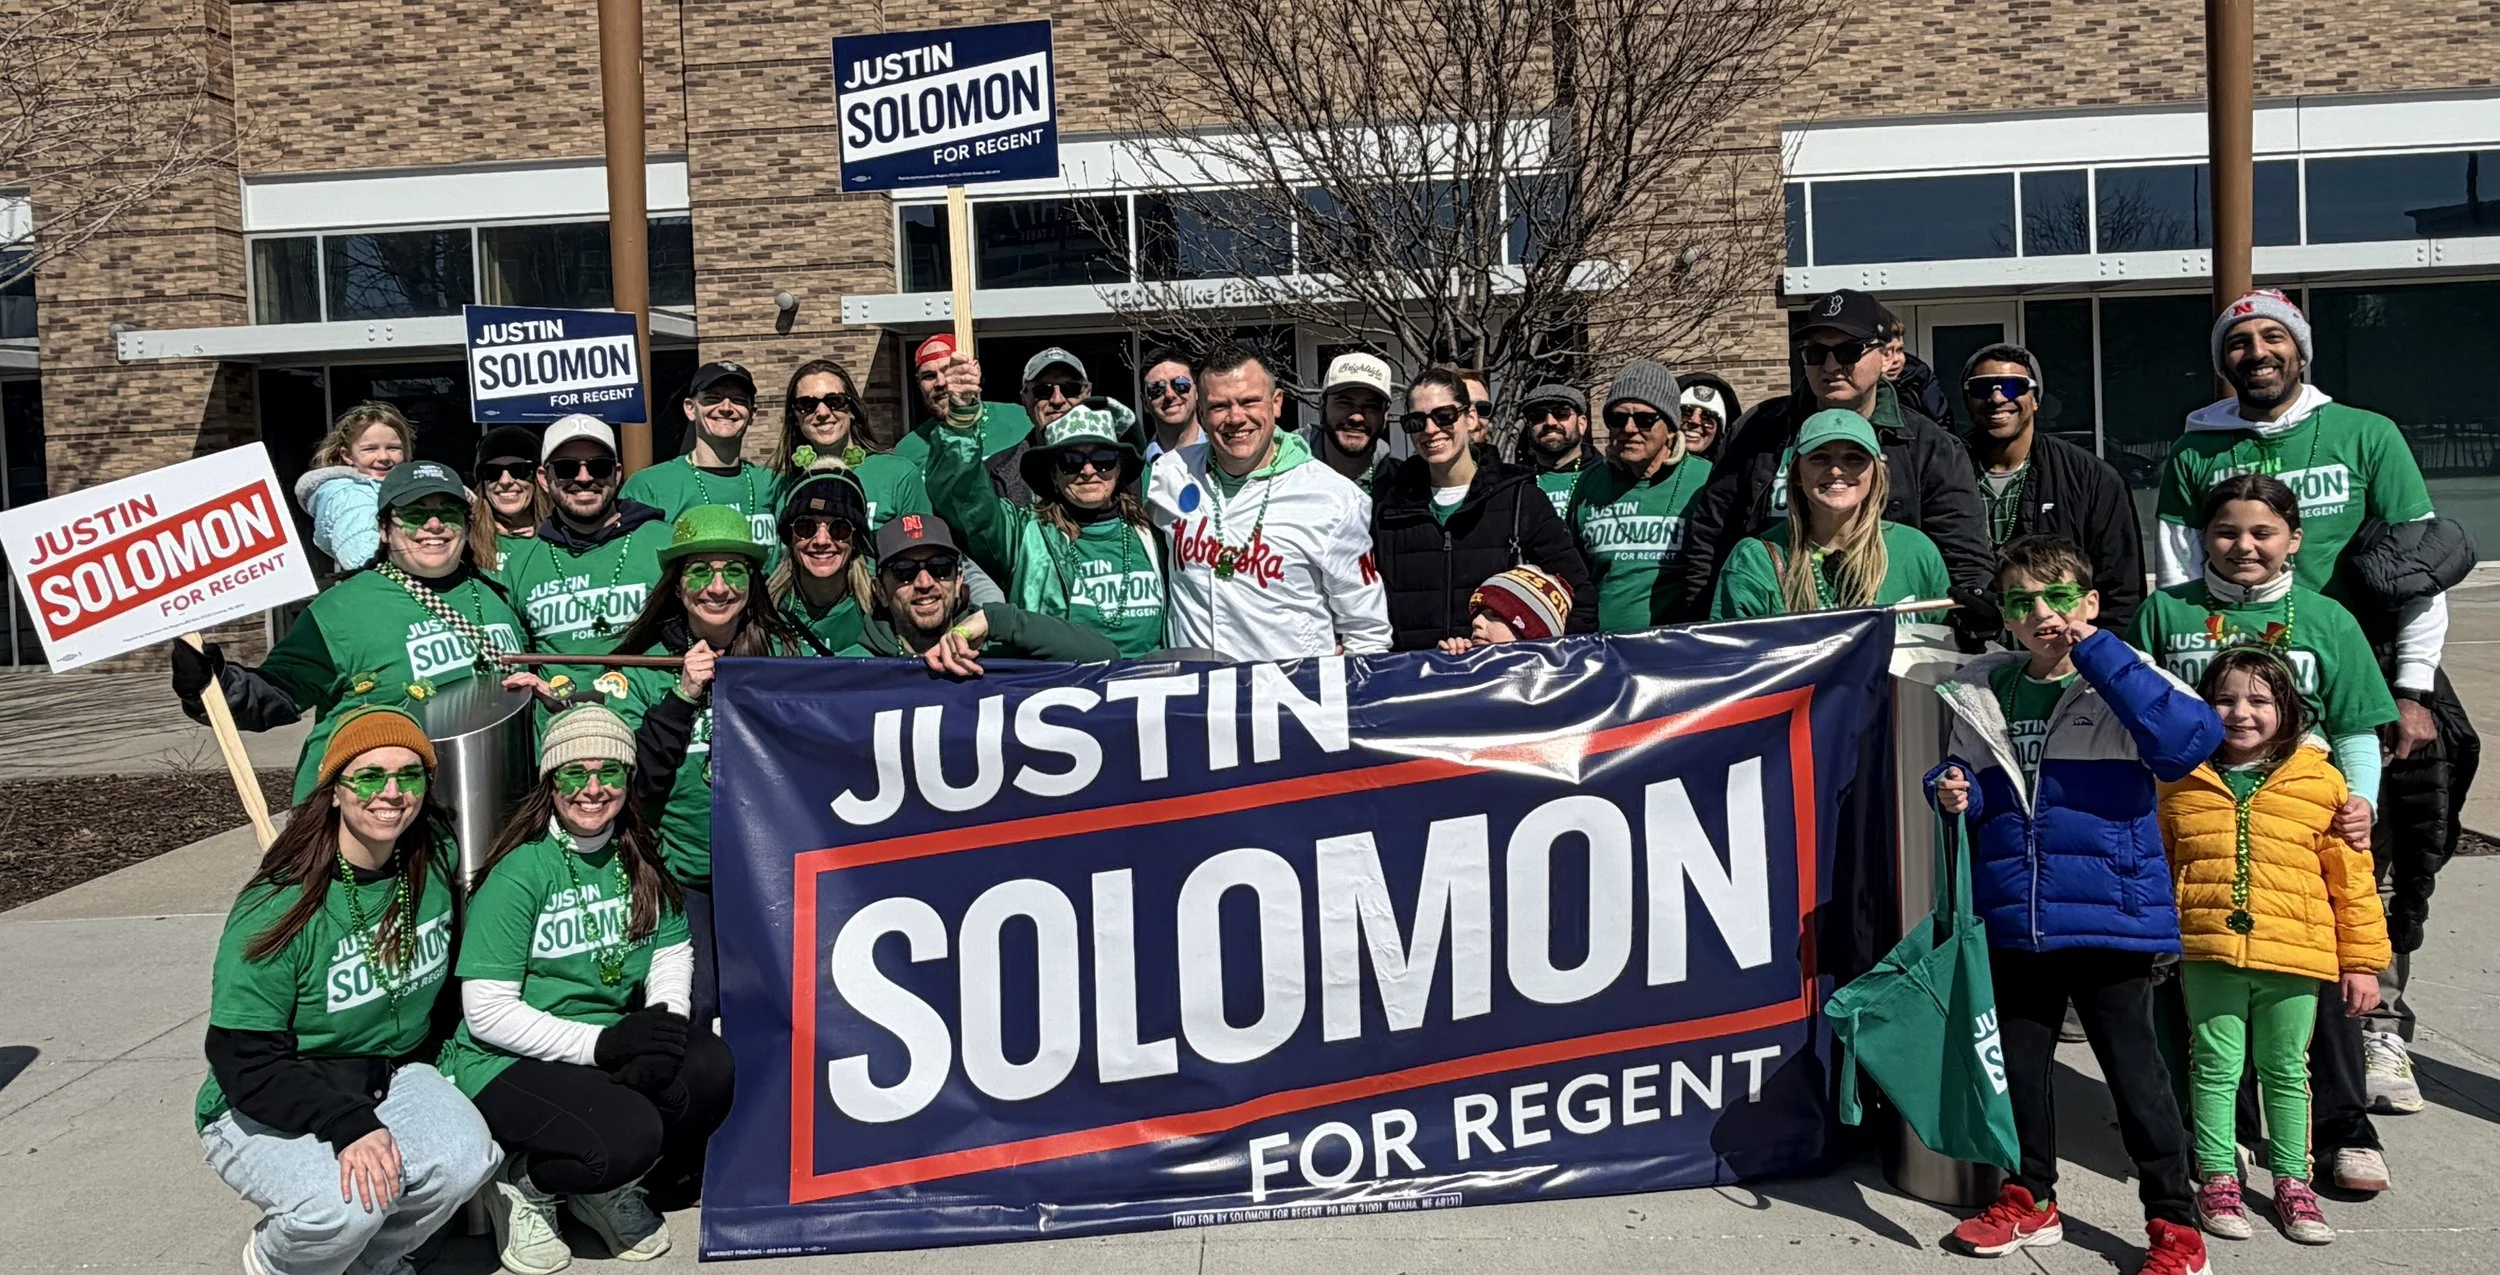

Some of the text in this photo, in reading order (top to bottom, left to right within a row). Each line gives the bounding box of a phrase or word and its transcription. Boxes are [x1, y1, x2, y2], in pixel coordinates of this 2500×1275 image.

[844, 41, 954, 89] JUSTIN
[846, 64, 1041, 149] SOLOMON
[934, 129, 1043, 165] FOR REGENT
[476, 318, 565, 345] JUSTIN
[478, 343, 632, 390] SOLOMON
[550, 387, 635, 407] FOR REGENT
[28, 493, 159, 565] JUSTIN
[902, 515, 923, 532] N
[1585, 500, 1639, 521] JUSTIN
[40, 492, 276, 627] SOLOMON
[1614, 551, 1677, 561] FOR REGENT
[160, 552, 286, 618] FOR REGENT
[527, 574, 591, 601] JUSTIN
[530, 590, 642, 631] SOLOMON
[412, 628, 519, 673] SOLOON
[572, 630, 596, 641] FOR
[830, 656, 1350, 826] JUSTIN
[827, 755, 1773, 1123] SOLOMON
[1249, 1045, 1782, 1202] FOR REGENT
[1177, 1214, 1196, 1227] PAID
[1198, 1213, 1215, 1226] FOR
[1217, 1212, 1228, 1224] BY
[1229, 1209, 1271, 1223] SOLOMON
[1273, 1207, 1289, 1219] FOR
[1341, 1203, 1357, 1214] BOX
